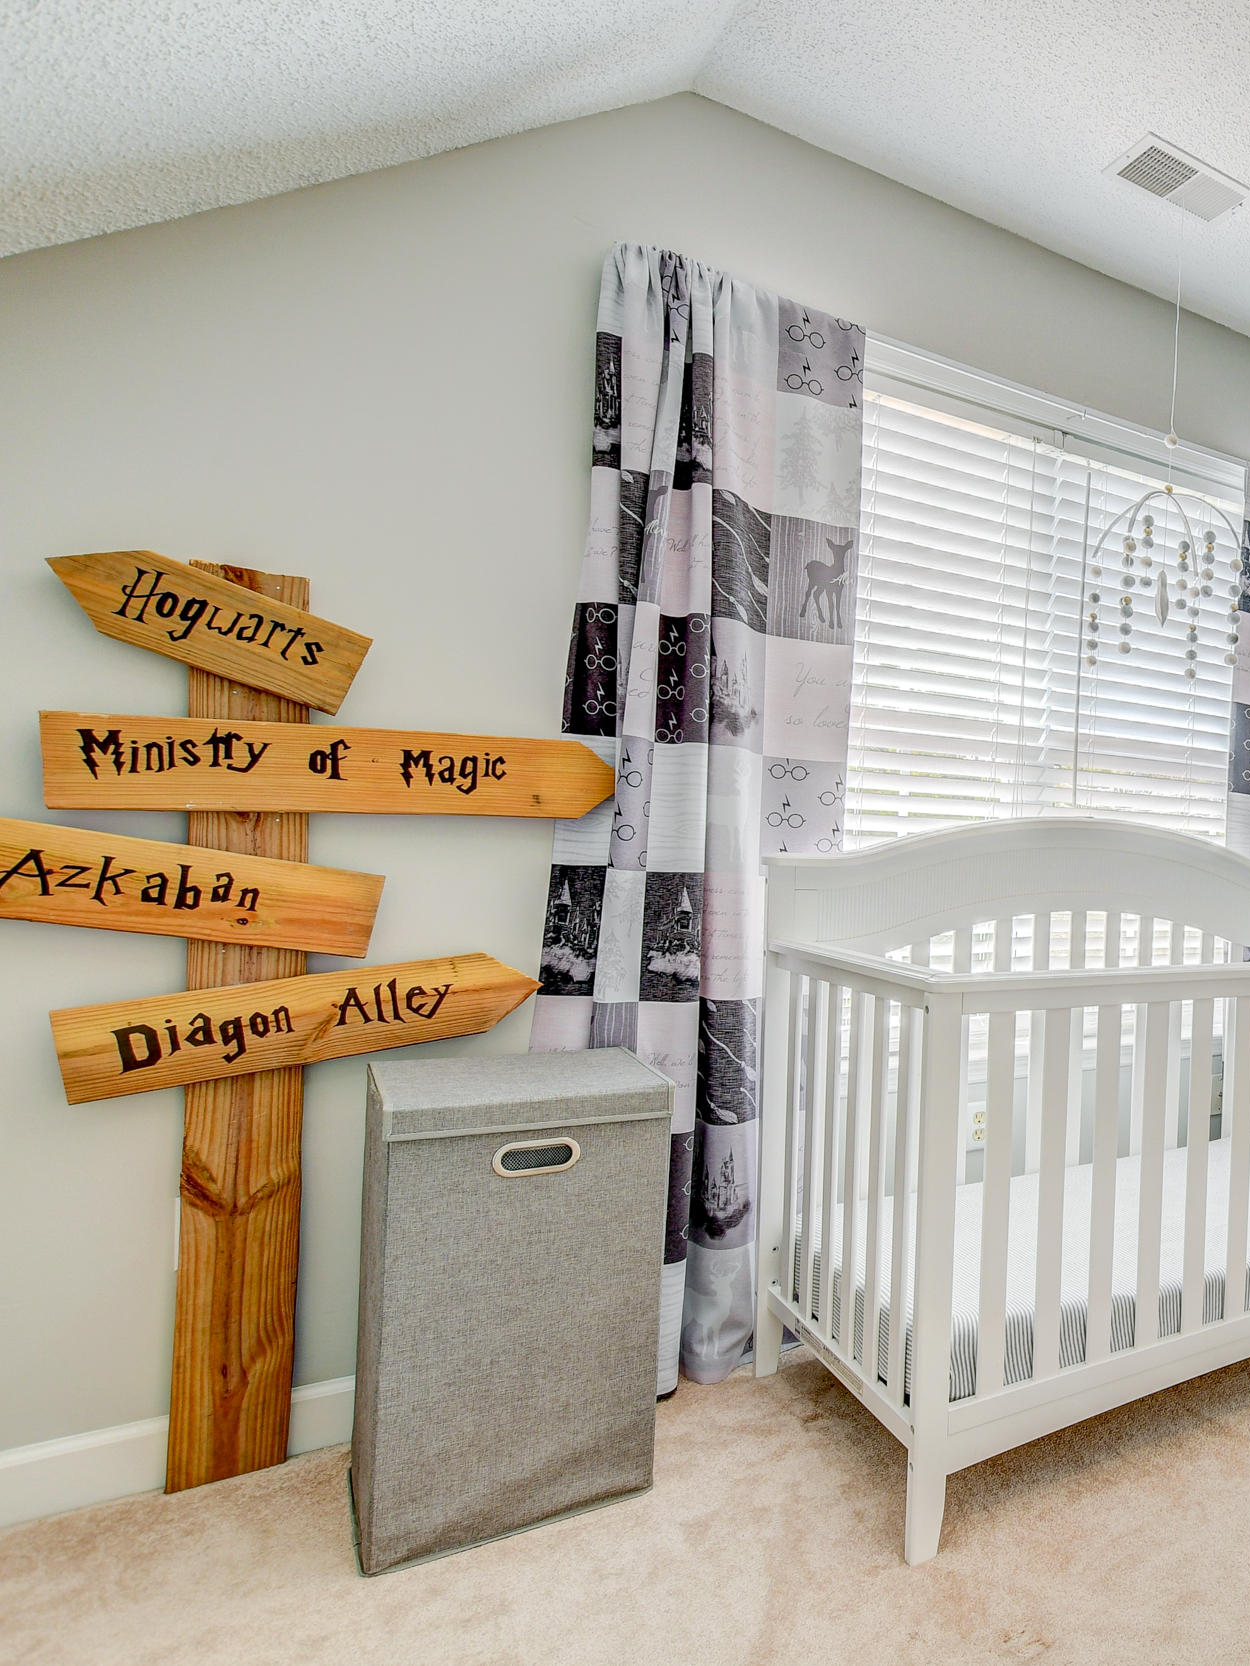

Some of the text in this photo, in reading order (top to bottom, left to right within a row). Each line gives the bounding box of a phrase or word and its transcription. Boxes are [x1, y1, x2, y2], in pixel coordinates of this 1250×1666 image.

[112, 566, 324, 667] Hogwarts
[75, 727, 507, 795] Ministry of Magic
[0, 849, 260, 912] Azkaban
[111, 978, 453, 1075] Diagon Alley
